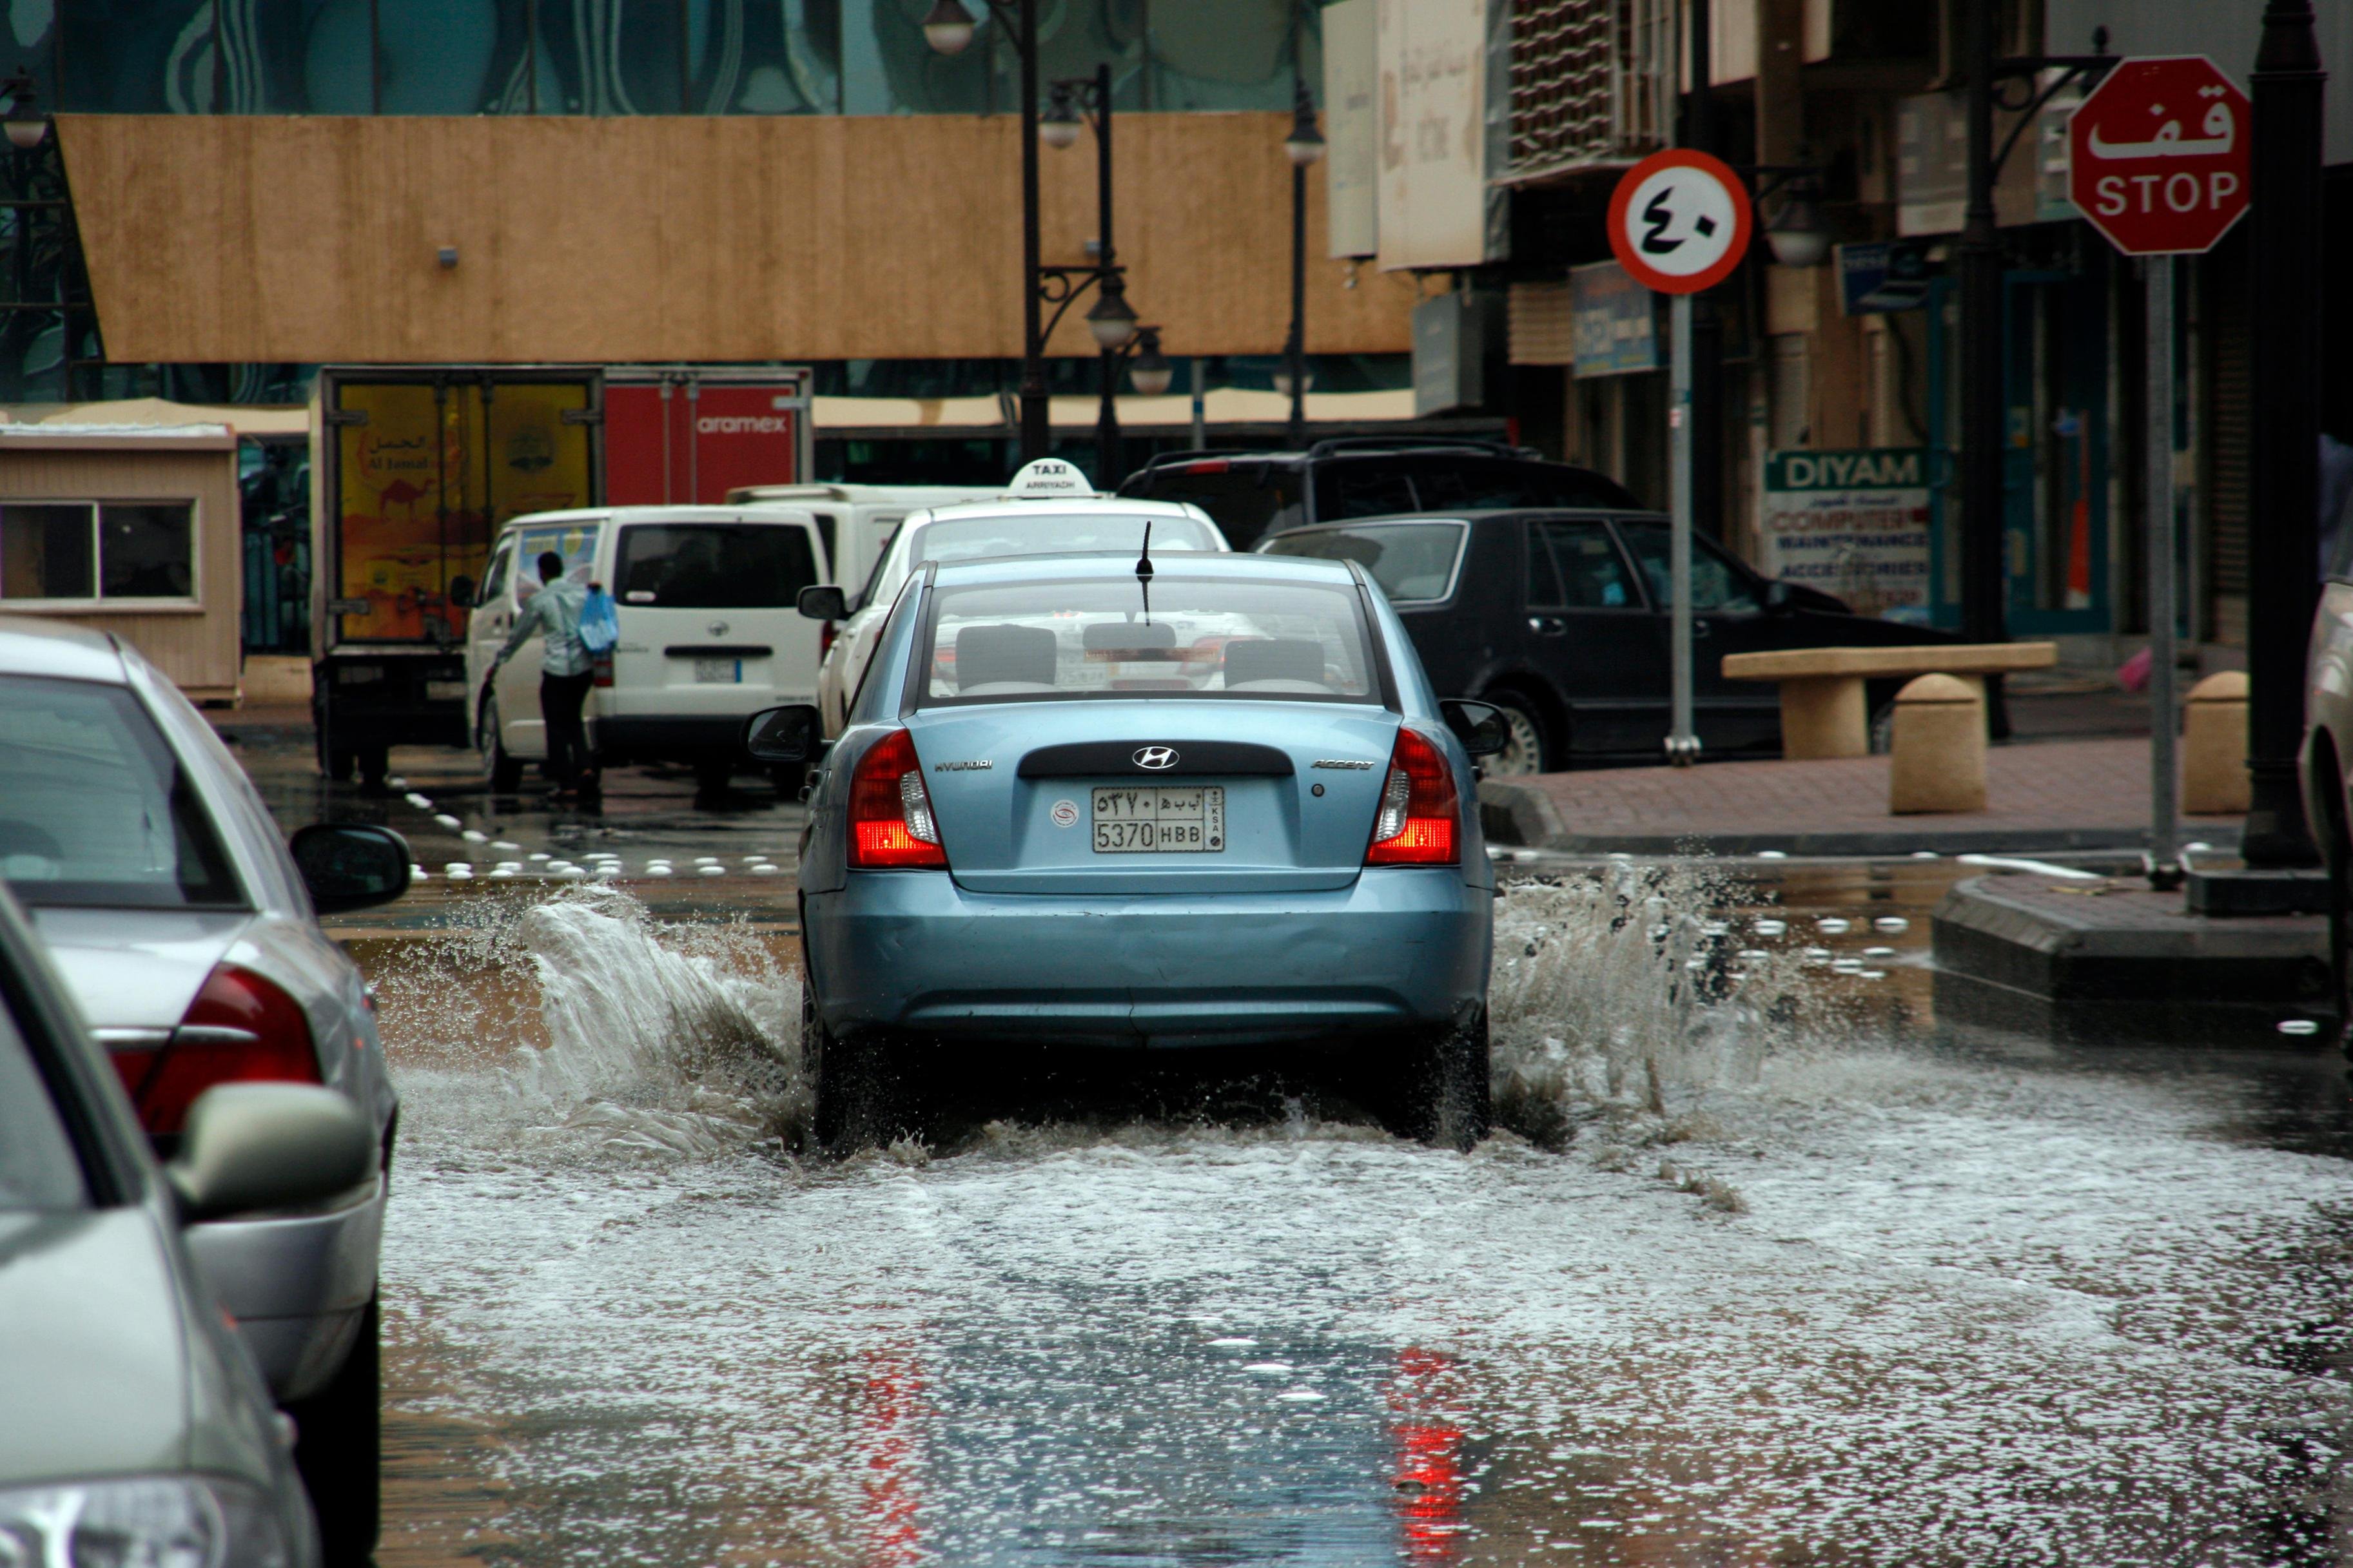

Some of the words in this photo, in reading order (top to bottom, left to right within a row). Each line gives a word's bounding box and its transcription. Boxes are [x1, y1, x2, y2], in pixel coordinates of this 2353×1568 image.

[2088, 84, 2235, 160] قف
[2095, 171, 2240, 217] STOP
[1641, 185, 1717, 255] ٤٠
[696, 416, 786, 434] aramex
[1032, 465, 1067, 475] TAXI
[1784, 453, 1919, 488] DIYAM
[934, 759, 993, 772] HYUNDAI
[1310, 759, 1375, 770] ACCENT
[1097, 822, 1153, 847] 5370
[1161, 826, 1200, 842] HBB
